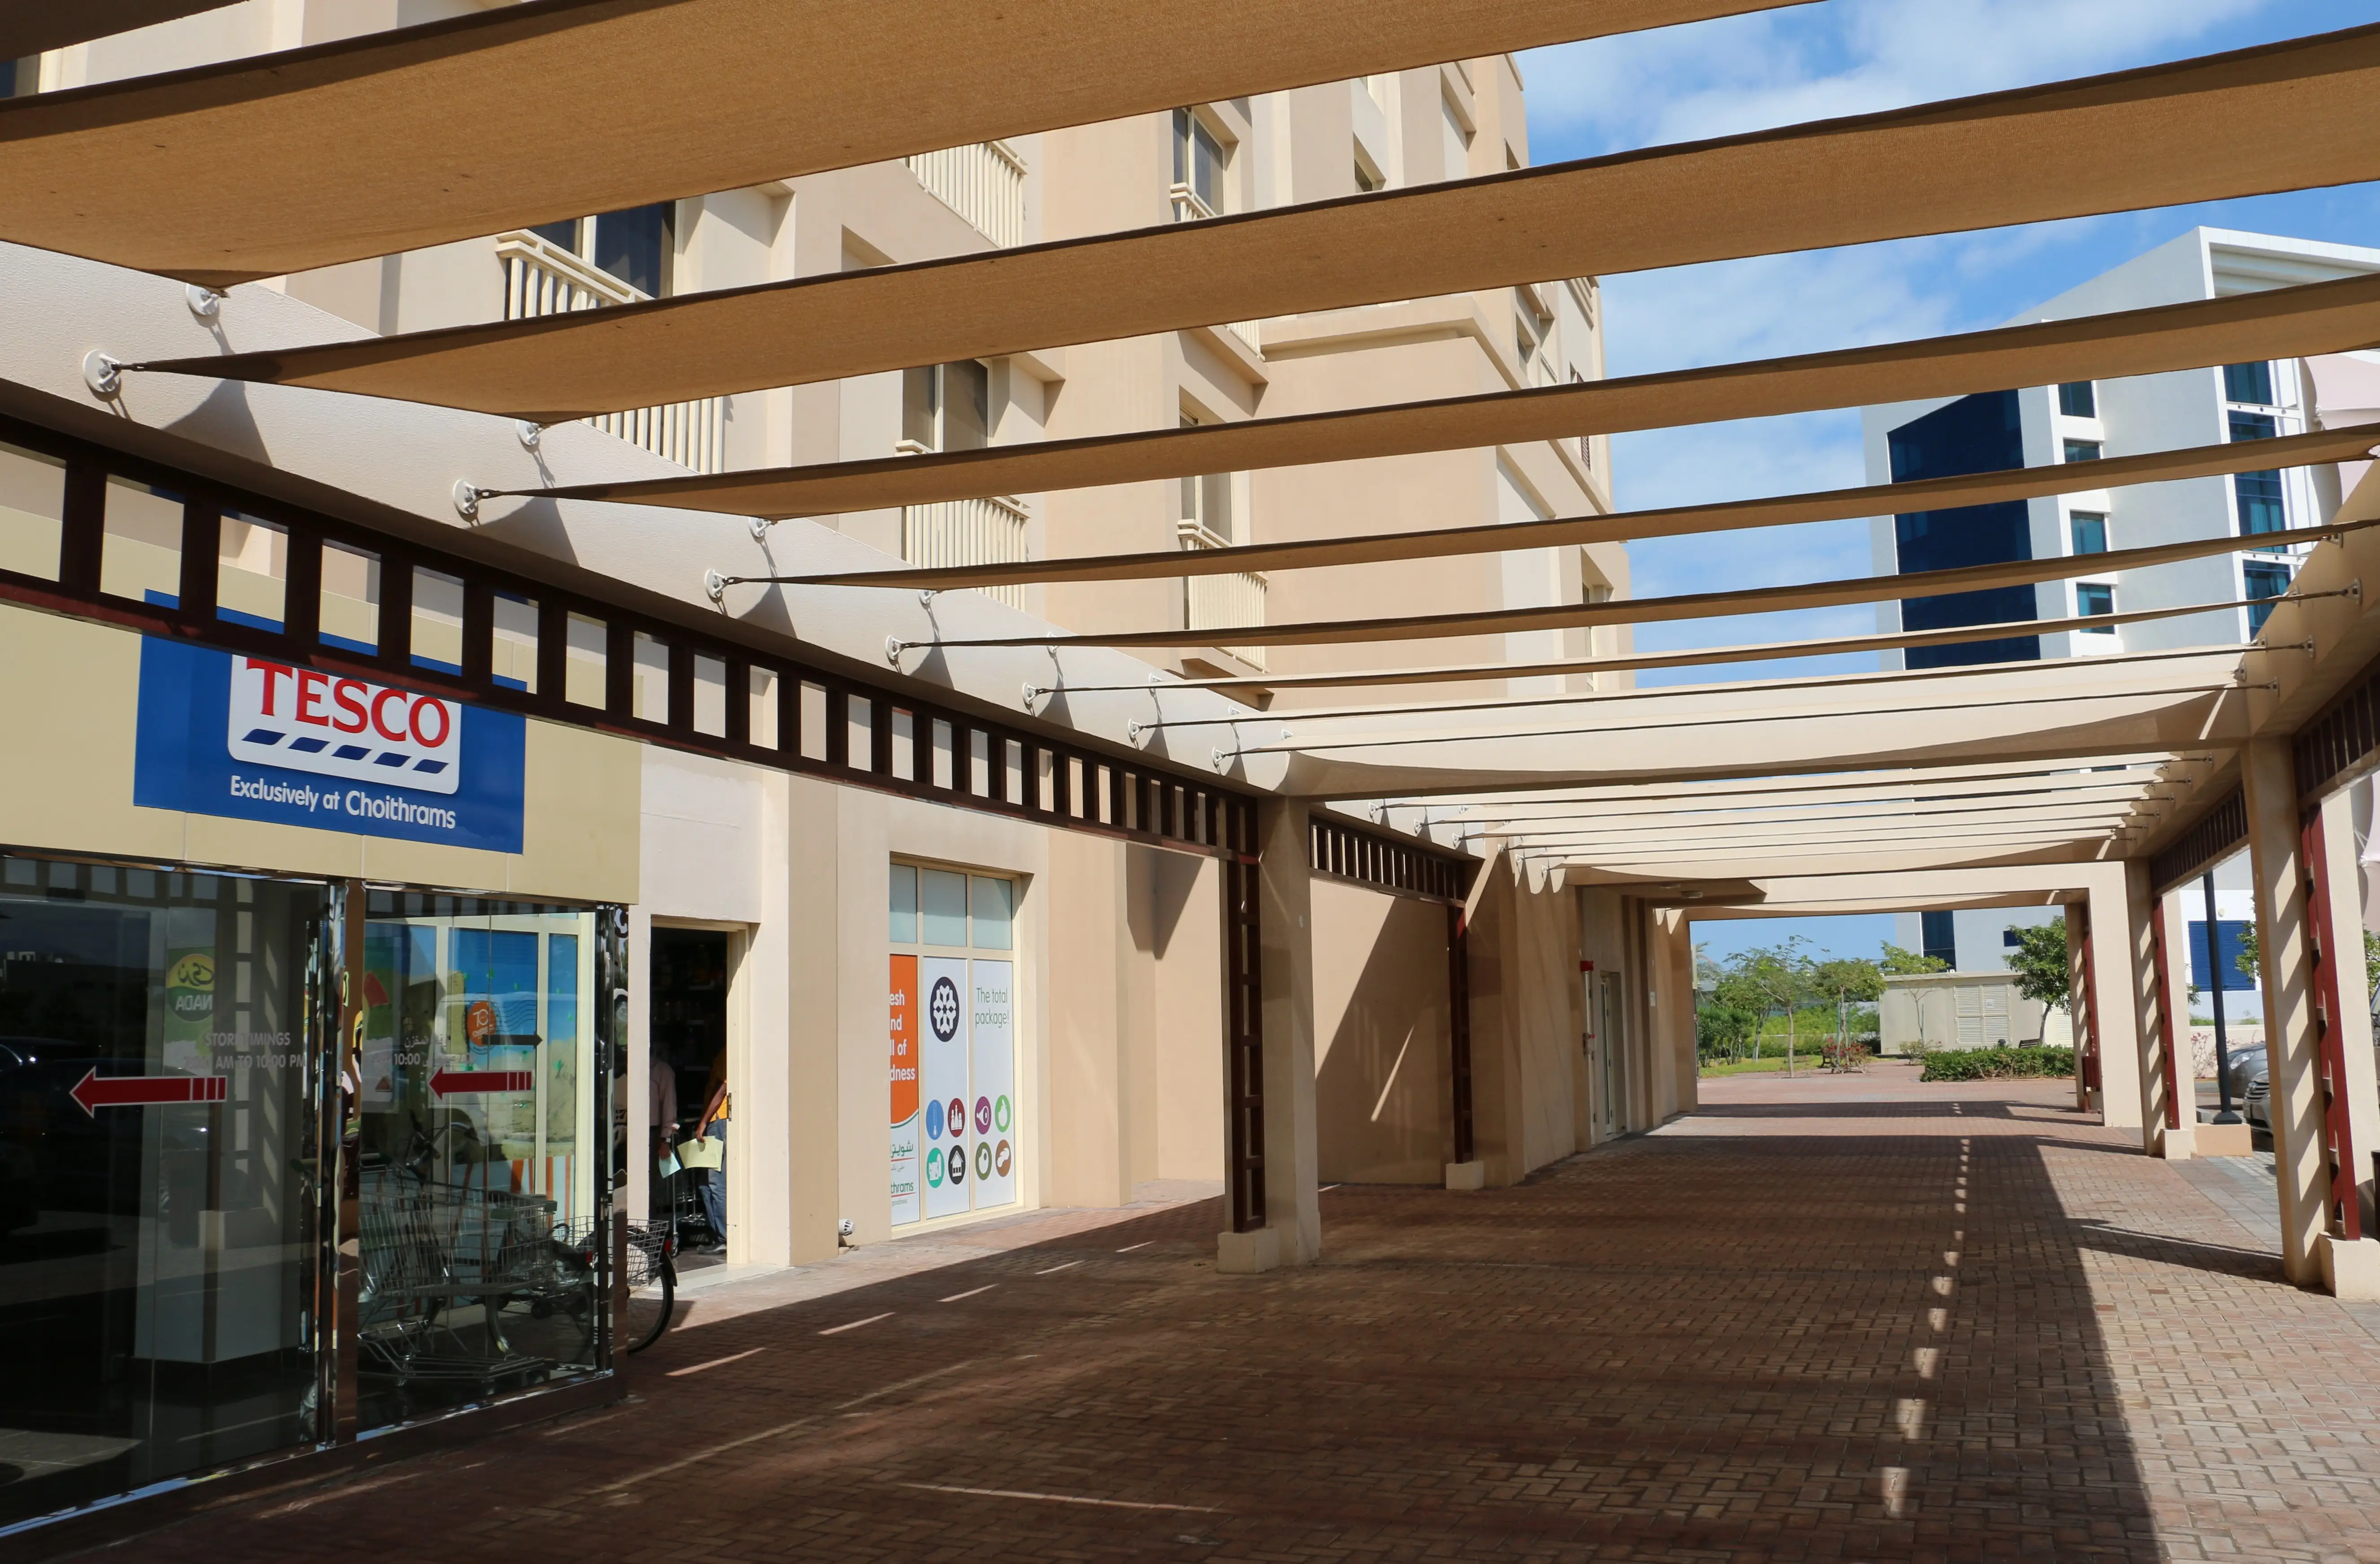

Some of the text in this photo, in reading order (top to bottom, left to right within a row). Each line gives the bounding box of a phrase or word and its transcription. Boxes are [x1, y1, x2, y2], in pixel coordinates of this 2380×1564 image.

[246, 658, 450, 748] TESCO
[231, 775, 456, 829] Exclusively at Choithrams
[977, 987, 1008, 1004] The total
[975, 1009, 1009, 1028] package!
[242, 1032, 291, 1046] TIMINGS
[897, 1039, 907, 1055] of
[215, 1055, 233, 1070] AM
[237, 1055, 253, 1069] TO
[290, 1054, 306, 1068] PM
[394, 1053, 420, 1065] 10:00
